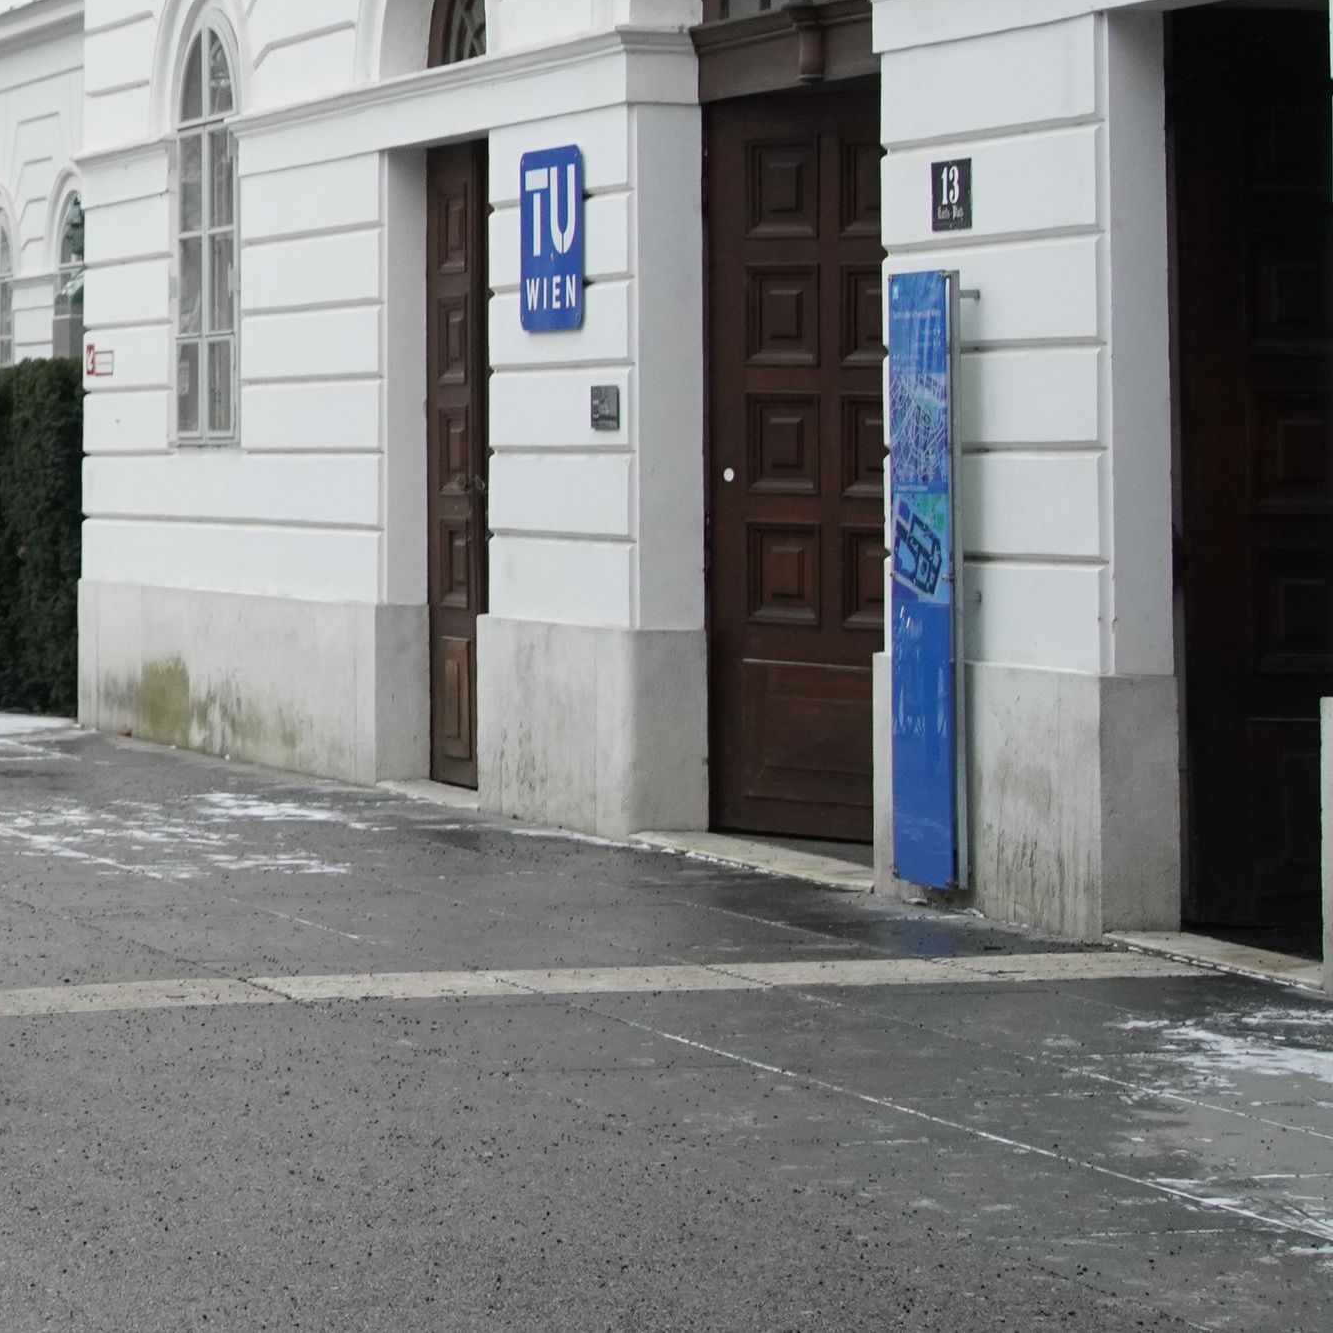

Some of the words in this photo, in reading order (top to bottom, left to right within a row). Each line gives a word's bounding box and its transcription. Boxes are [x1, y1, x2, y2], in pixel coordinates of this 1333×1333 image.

[941, 165, 960, 206] 13
[525, 163, 576, 257] TU
[526, 273, 577, 311] WIEN
